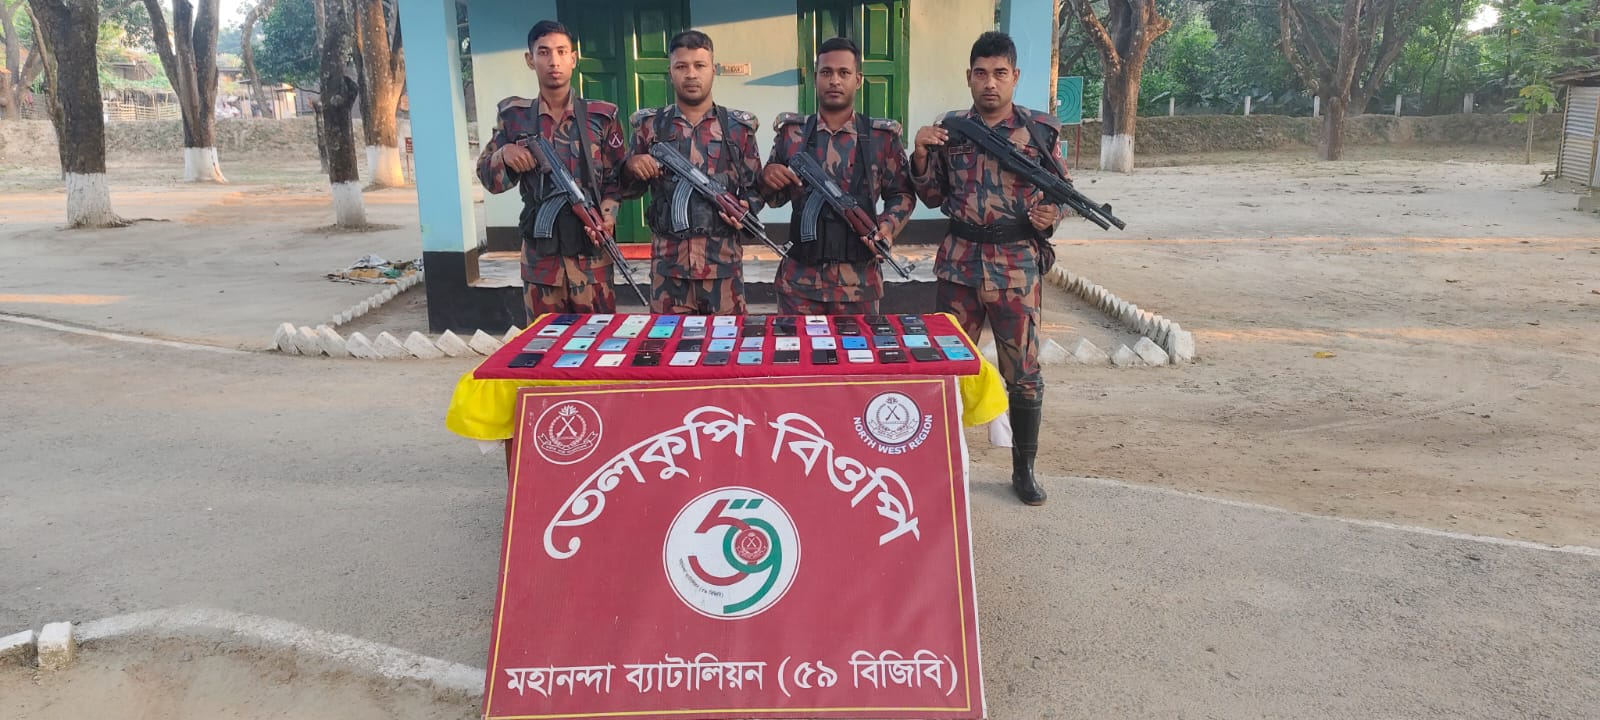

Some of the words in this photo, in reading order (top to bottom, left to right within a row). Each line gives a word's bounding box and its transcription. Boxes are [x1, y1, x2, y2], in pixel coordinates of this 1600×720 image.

[853, 416, 877, 449] NORTH
[878, 444, 907, 455] WEST
[908, 414, 933, 450] REGION
[543, 405, 756, 560] তেলকুপি
[767, 412, 920, 546] বিওপি
[504, 662, 617, 698] মহানন্দা
[623, 652, 768, 693] ব্যাটালিয়ন
[777, 655, 838, 698] (৫৯
[847, 649, 958, 697] বিজিবি)
